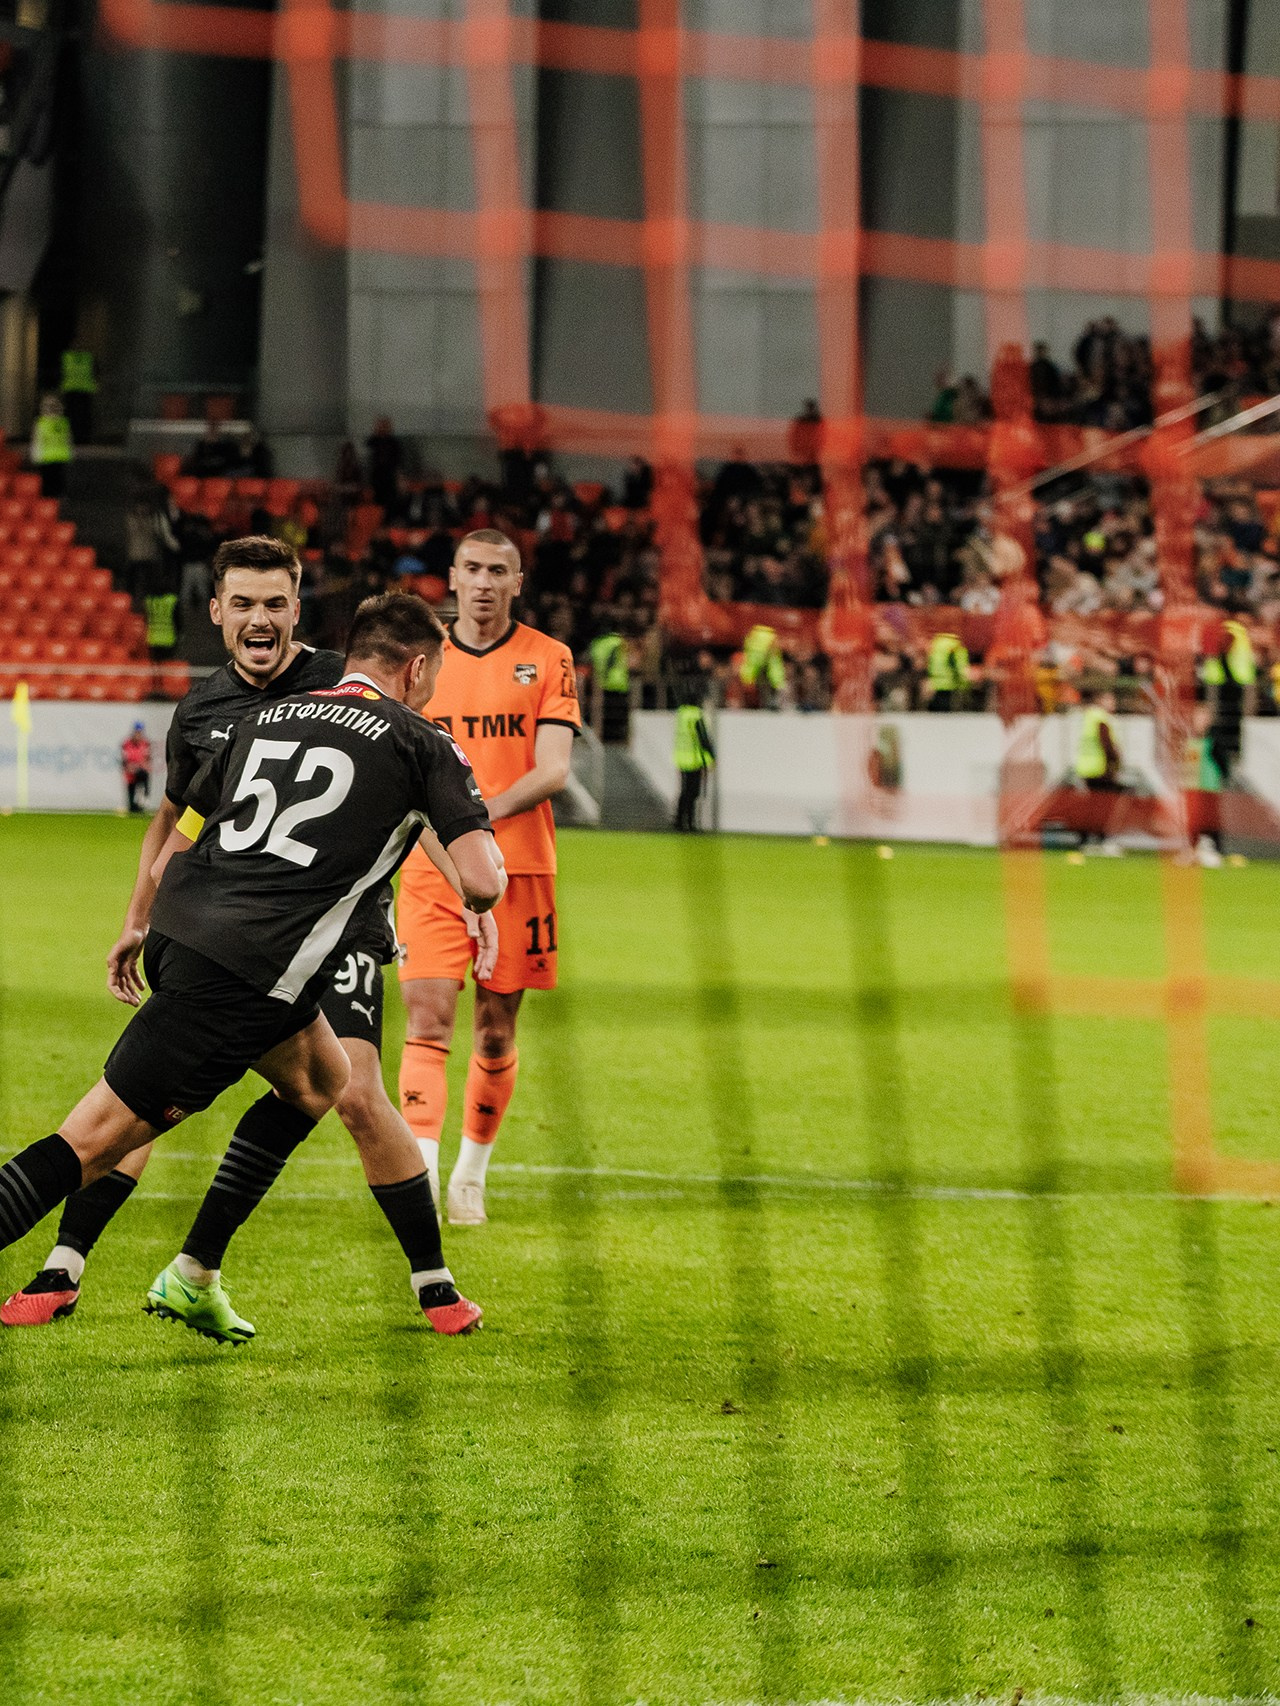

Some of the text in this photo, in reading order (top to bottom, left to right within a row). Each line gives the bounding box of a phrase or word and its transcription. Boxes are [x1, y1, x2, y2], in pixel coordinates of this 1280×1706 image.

[257, 702, 391, 741] НЕТФУЛЛИН
[219, 738, 355, 867] 52
[526, 913, 557, 955] 11
[333, 951, 376, 996] 97
